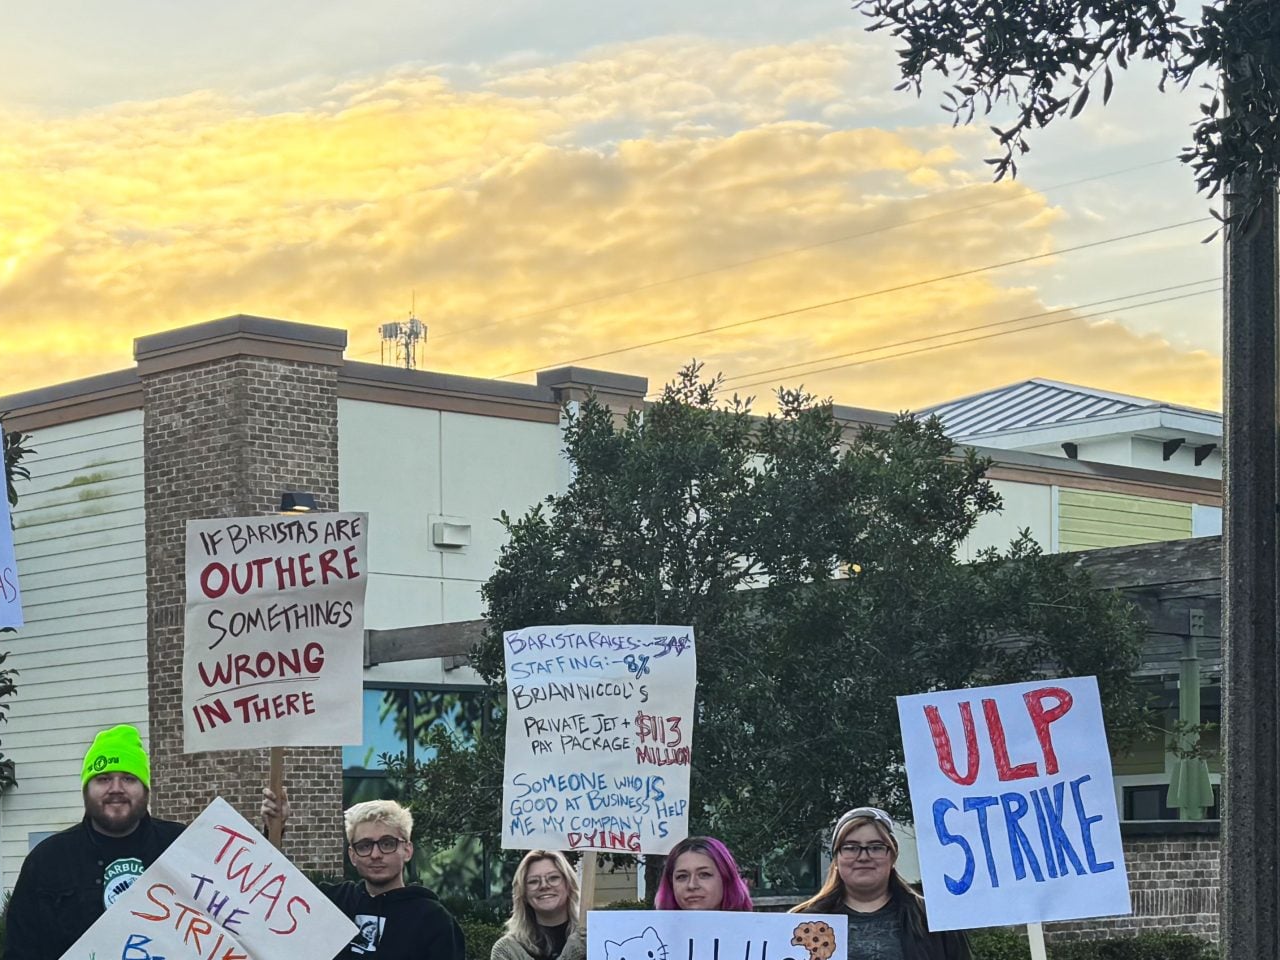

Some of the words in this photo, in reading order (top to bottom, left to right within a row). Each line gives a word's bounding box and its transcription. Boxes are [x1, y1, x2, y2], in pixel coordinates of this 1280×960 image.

[199, 530, 223, 555] IF
[226, 520, 318, 554] BARISTAS
[324, 518, 361, 544] ARE
[207, 600, 353, 650] SOMETHINGS
[506, 632, 588, 655] BARISTA
[198, 642, 325, 688] WRONG
[192, 698, 232, 733] IN
[233, 691, 316, 724] THERE
[511, 682, 575, 710] BRIAN
[524, 714, 590, 737] PRIVATE
[591, 714, 619, 734] JET
[635, 710, 682, 747] $113
[923, 686, 1074, 786] ULP
[532, 740, 553, 755] PAY
[636, 746, 690, 766] MILLION
[513, 772, 608, 798] SOMEONE
[614, 776, 643, 791] WHO
[645, 777, 665, 801] IS
[510, 798, 558, 817] GOOD
[566, 799, 582, 811] AT
[586, 790, 651, 815] BUSINESS
[655, 799, 687, 819] HELP
[510, 816, 536, 836] ME
[543, 817, 566, 834] MY
[570, 815, 643, 835] COMPANY
[651, 821, 669, 838] IS
[567, 829, 641, 852] DYING
[931, 774, 1115, 896] STRIKE
[213, 824, 312, 935] TWAS
[190, 873, 251, 936] THE
